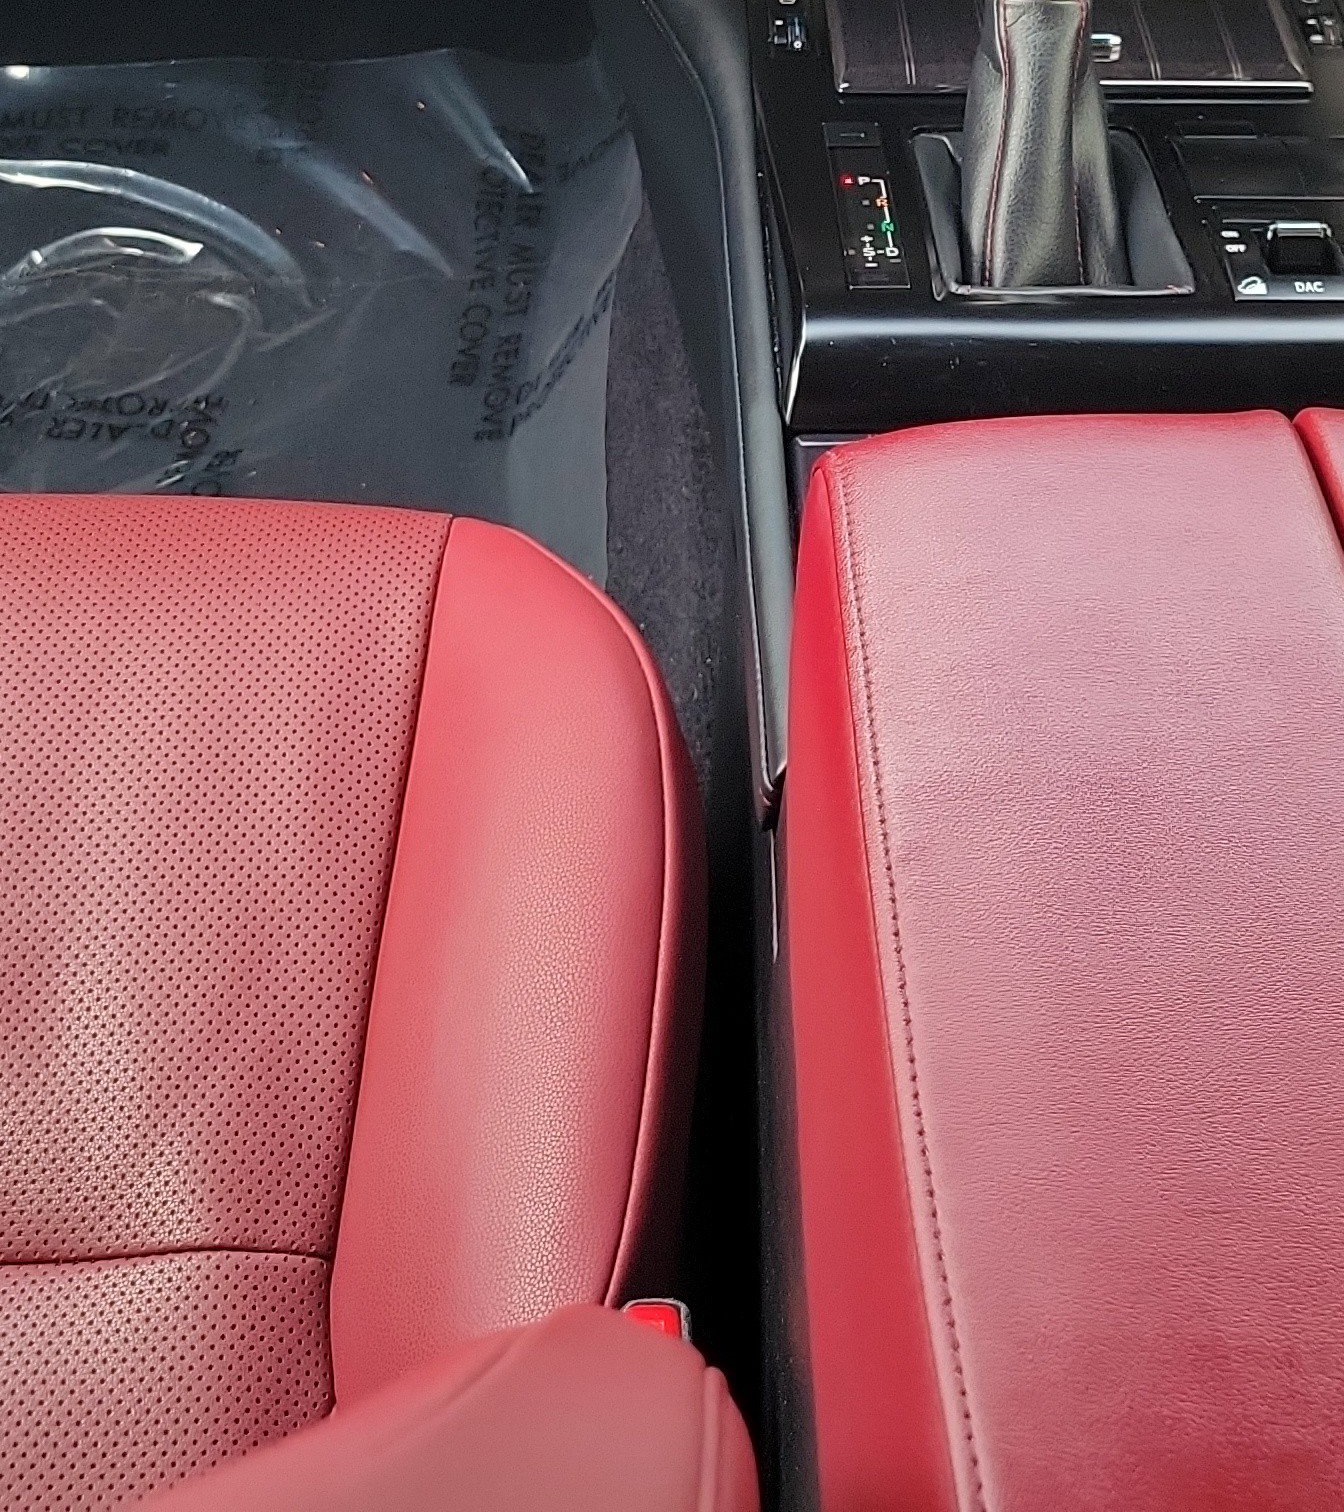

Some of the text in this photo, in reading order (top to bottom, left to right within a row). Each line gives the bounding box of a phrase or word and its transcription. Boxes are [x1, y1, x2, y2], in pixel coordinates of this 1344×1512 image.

[857, 176, 871, 185] P
[876, 198, 888, 207] R
[881, 222, 894, 232] N
[862, 247, 876, 257] S
[885, 247, 899, 257] D
[1294, 281, 1324, 293] DAC
